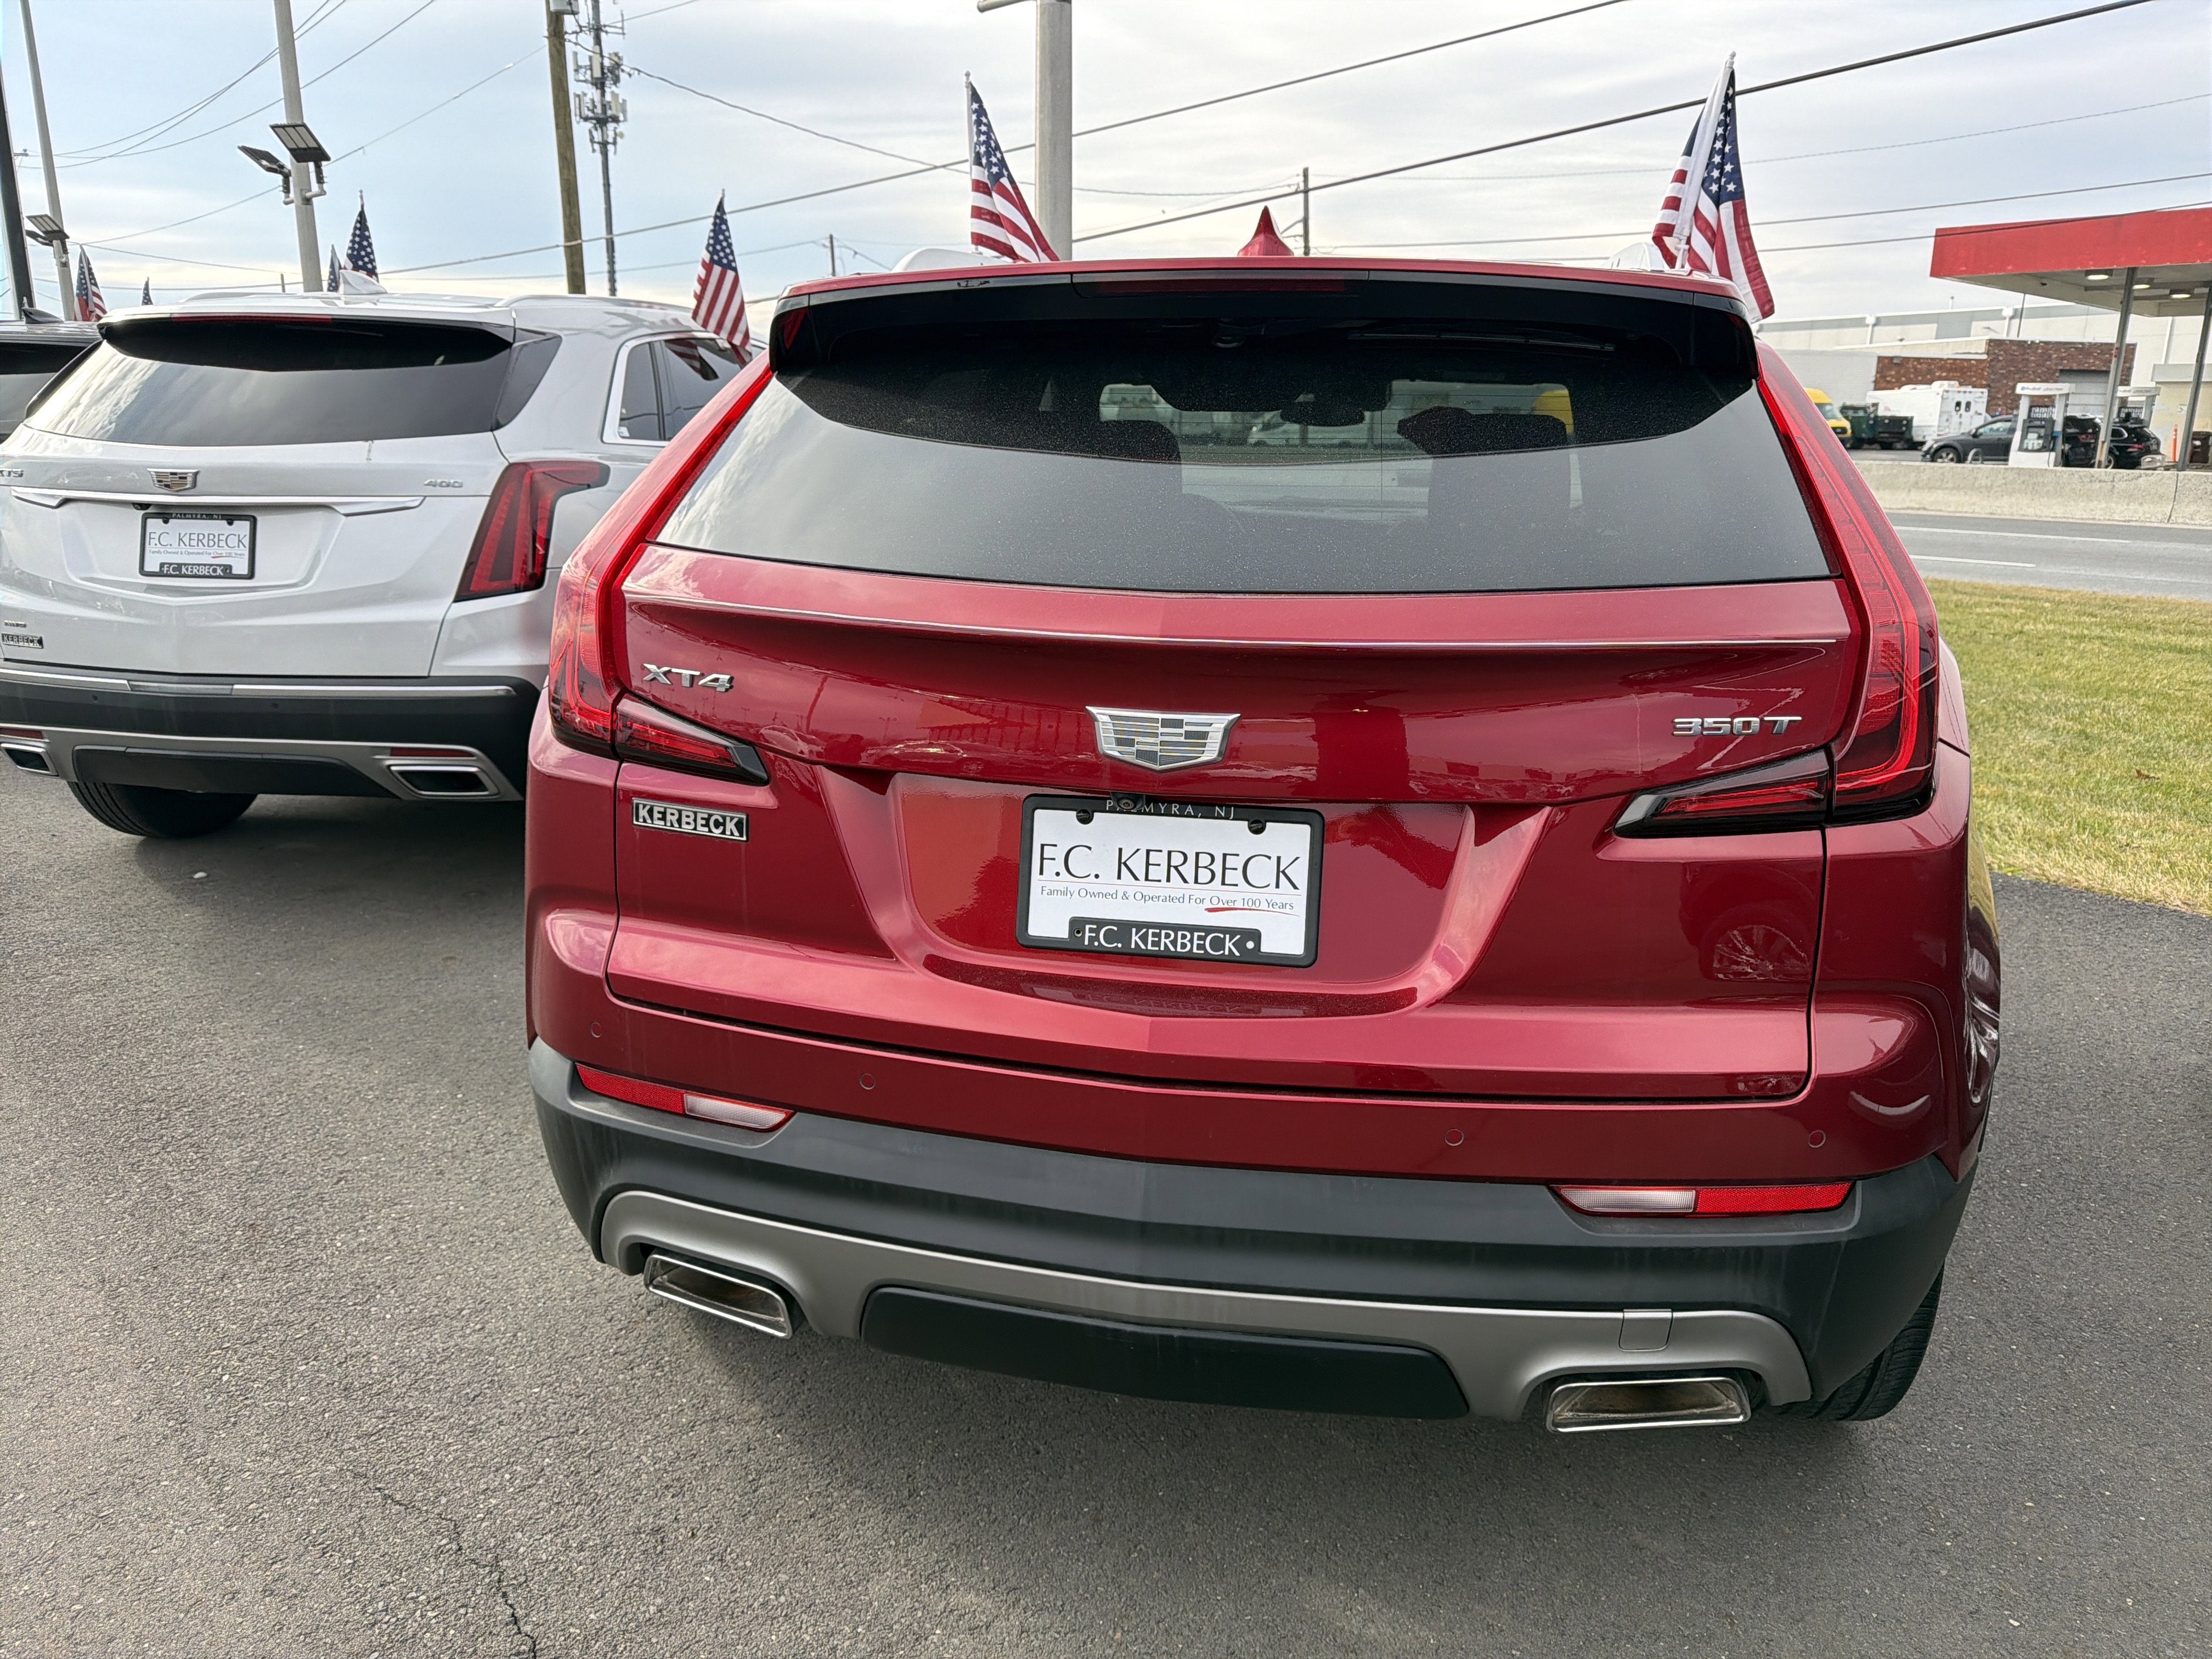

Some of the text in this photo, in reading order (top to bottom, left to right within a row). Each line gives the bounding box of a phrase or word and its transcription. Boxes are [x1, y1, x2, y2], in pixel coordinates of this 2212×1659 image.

[424, 479, 462, 488] 400
[148, 532, 247, 549] F.C. KERBECK
[163, 564, 224, 576] F.C. KERBECK
[3, 634, 40, 646] KERBECK
[642, 663, 733, 692] XT4
[1672, 716, 1803, 736] 350T
[1106, 799, 1234, 820] PMYRA, NJ
[639, 804, 740, 837] KERBECK
[1039, 843, 1301, 890] F.C. KERBECK
[1041, 886, 1294, 910] Family Owned & Operated For Over 100 Years
[1084, 924, 1241, 956] F.C. KERBECK
